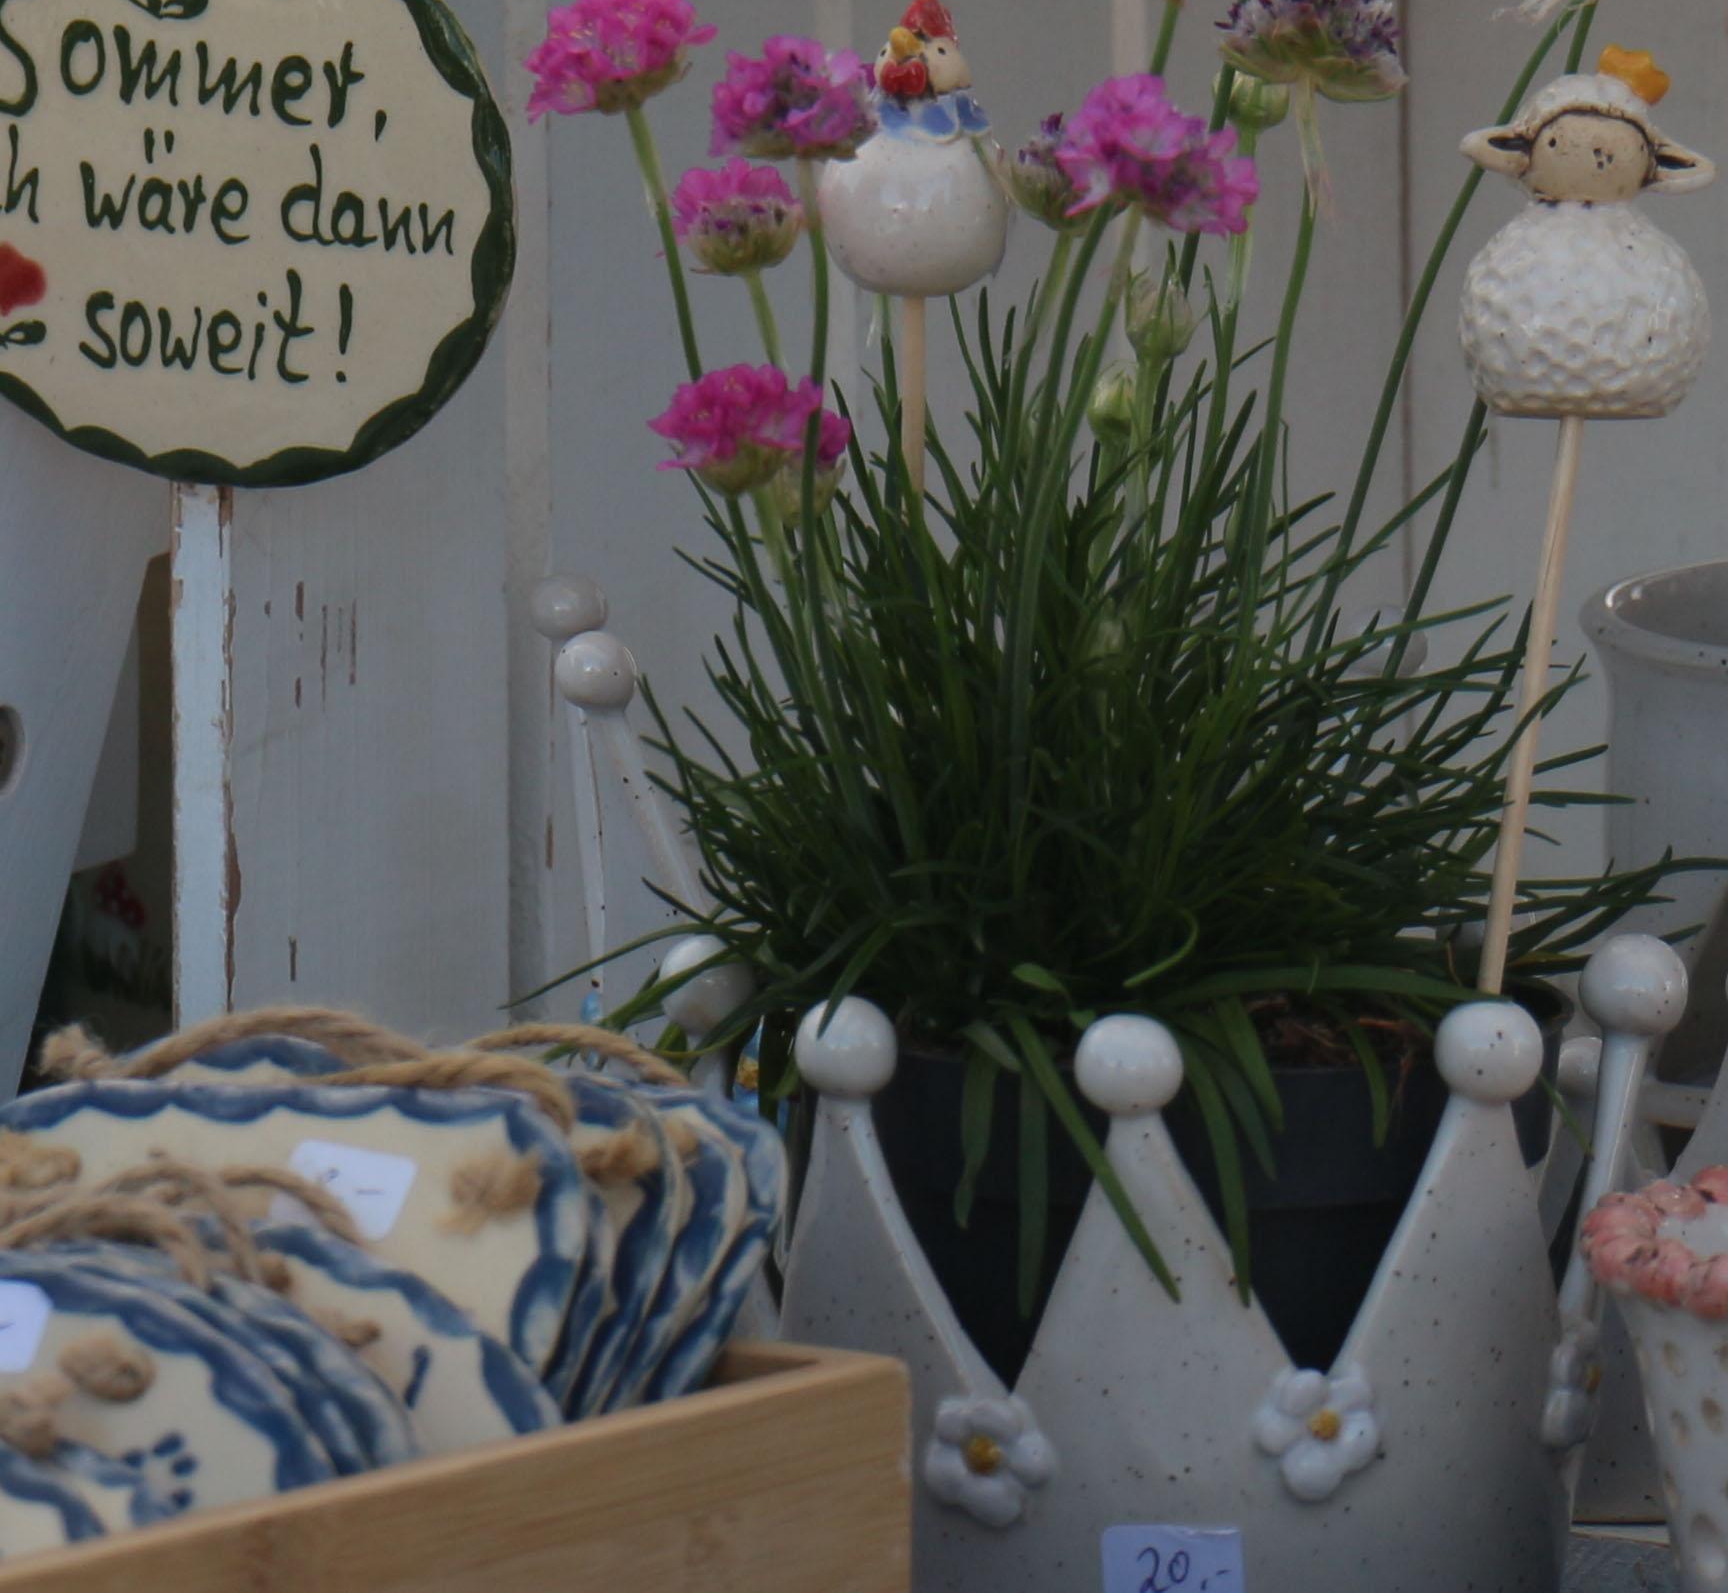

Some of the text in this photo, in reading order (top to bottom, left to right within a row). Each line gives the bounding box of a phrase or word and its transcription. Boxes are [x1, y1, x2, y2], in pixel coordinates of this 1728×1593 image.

[80, 127, 251, 246] wäre
[281, 143, 455, 256] dann
[79, 268, 353, 384] soweit!
